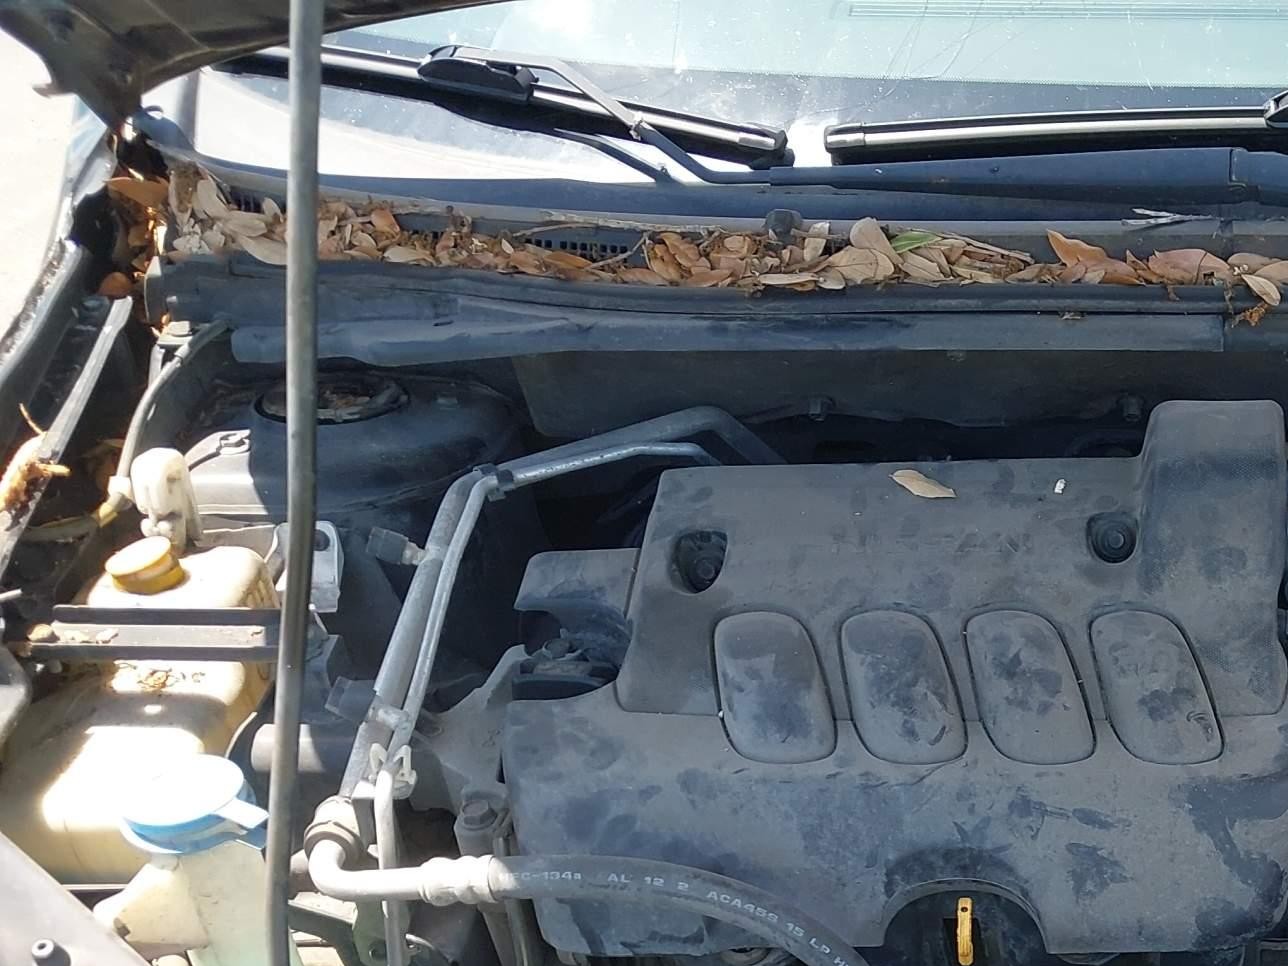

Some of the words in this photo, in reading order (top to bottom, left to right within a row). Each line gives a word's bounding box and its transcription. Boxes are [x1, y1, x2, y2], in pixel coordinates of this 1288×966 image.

[607, 873, 630, 883] AL
[644, 876, 664, 887] 12
[677, 882, 689, 891] 2
[786, 922, 806, 937] 15
